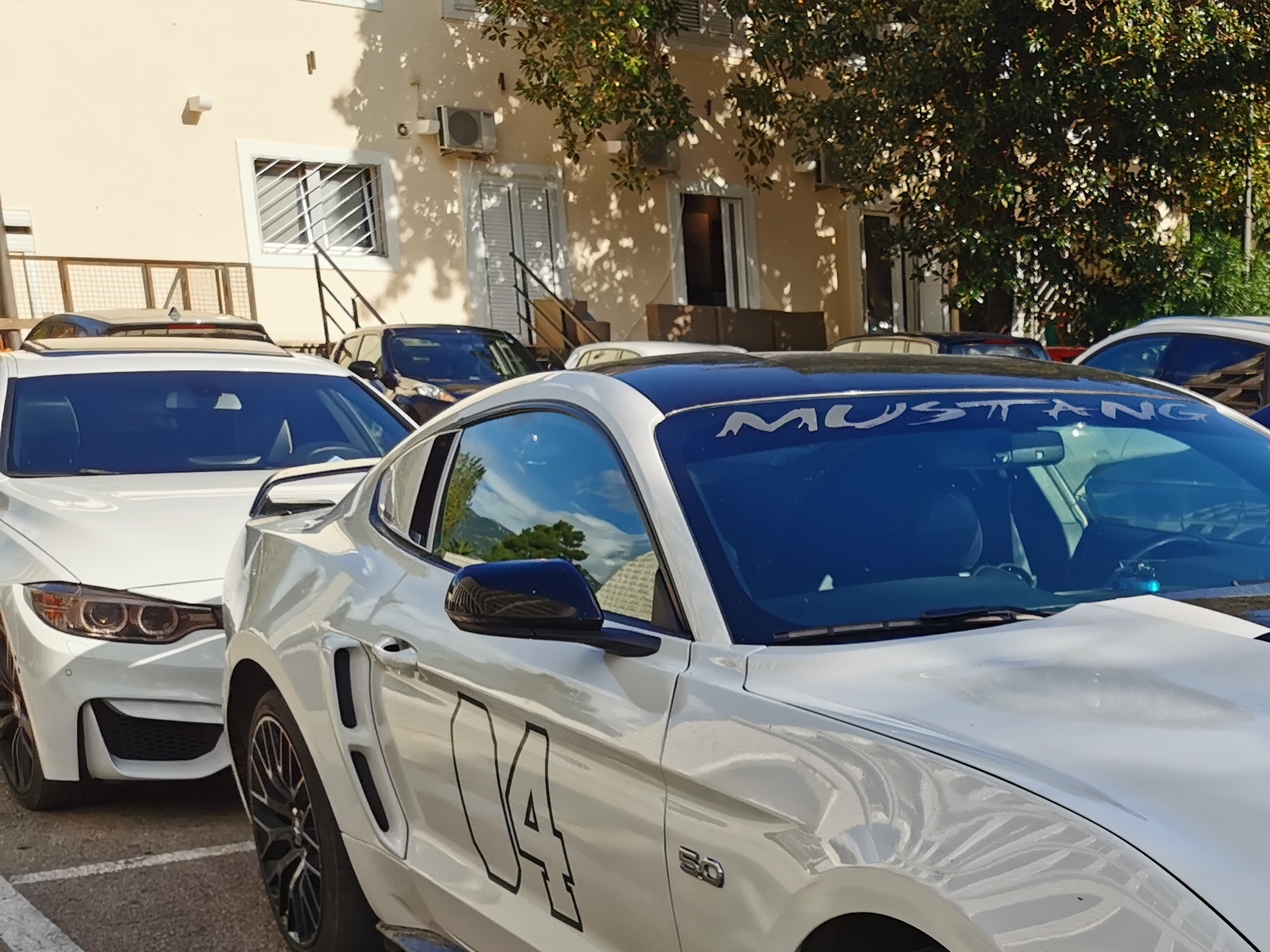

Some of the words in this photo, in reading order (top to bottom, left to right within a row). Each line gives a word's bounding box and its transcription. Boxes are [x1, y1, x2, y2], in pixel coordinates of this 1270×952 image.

[715, 399, 1207, 438] MUSTANG
[450, 690, 584, 933] 04
[678, 845, 725, 889] 5.0
